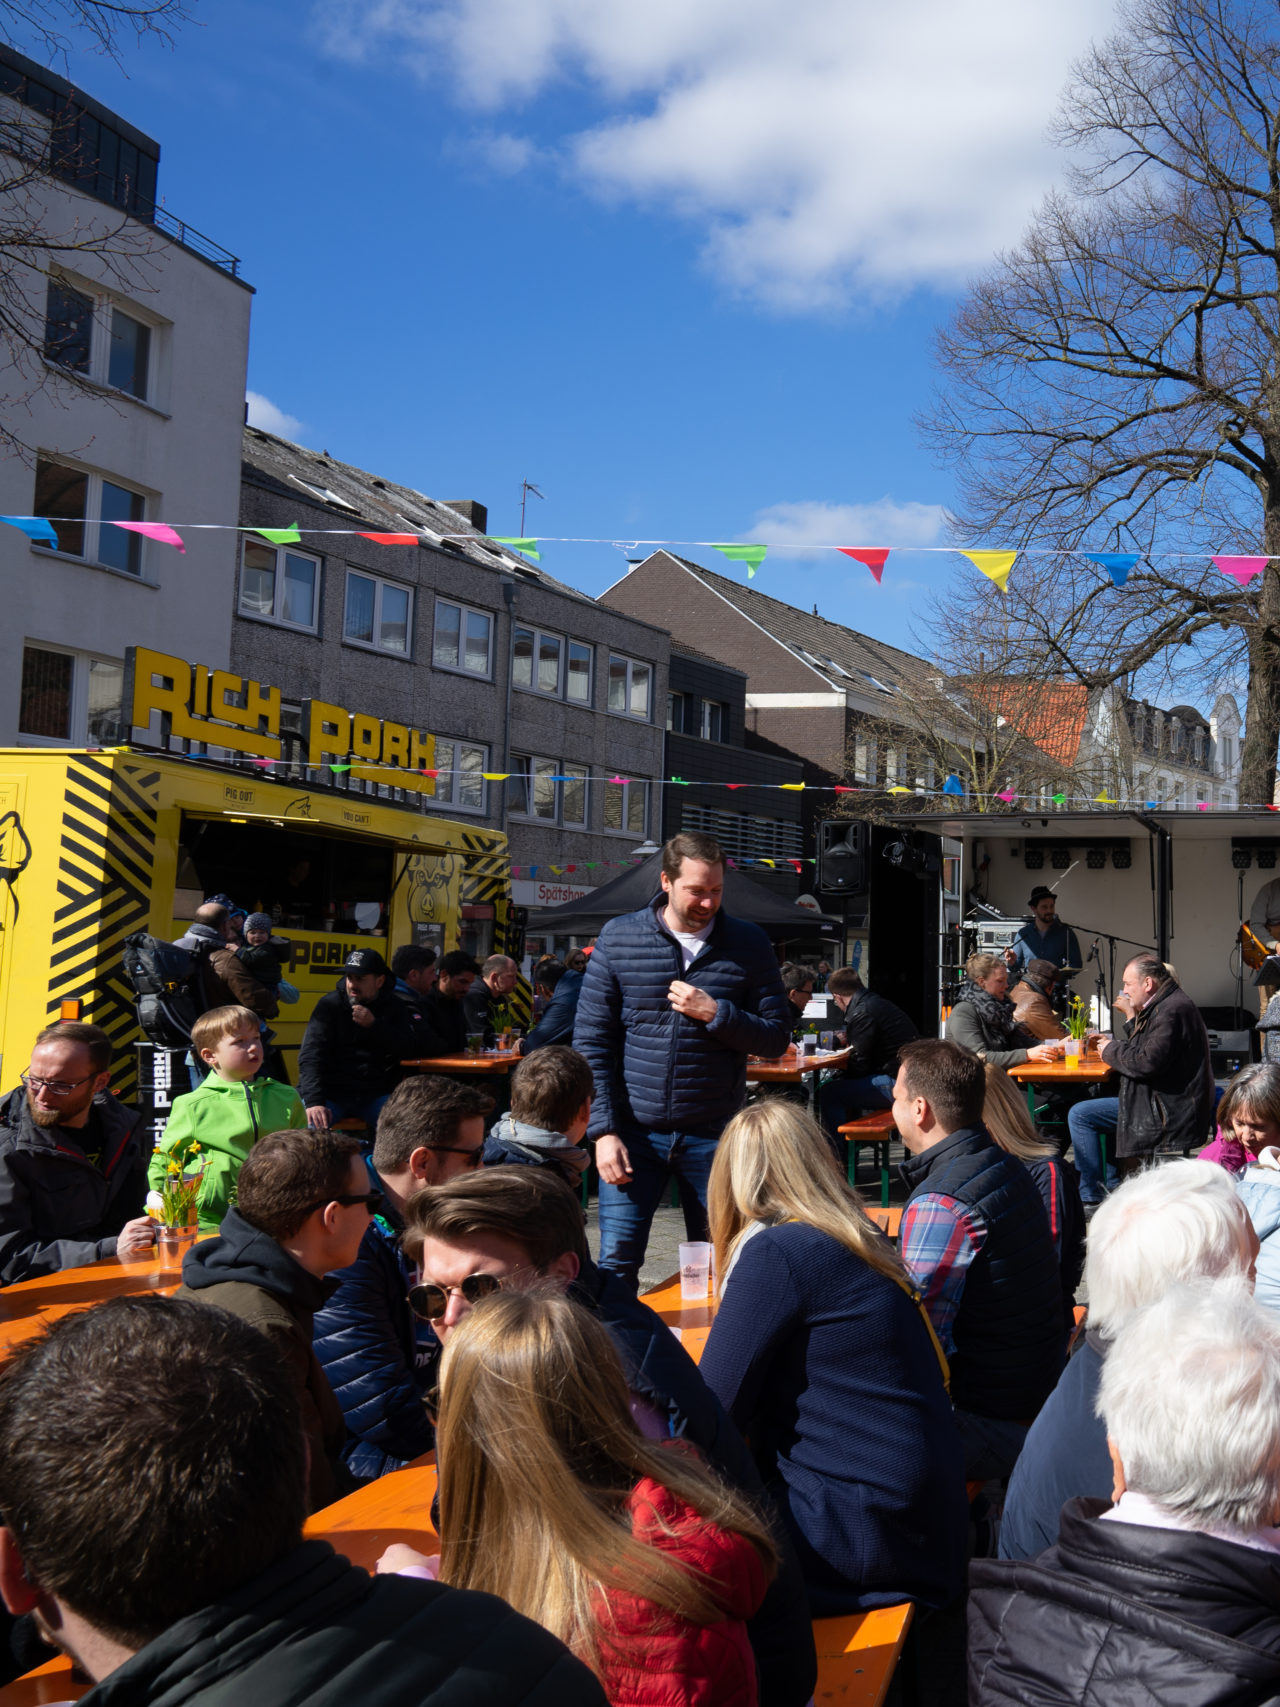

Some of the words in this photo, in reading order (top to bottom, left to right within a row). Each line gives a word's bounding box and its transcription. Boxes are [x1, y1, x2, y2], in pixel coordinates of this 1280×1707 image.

[132, 645, 281, 760] RICH
[309, 699, 436, 796] PORK
[225, 787, 238, 799] PIG
[240, 790, 253, 802] OUT
